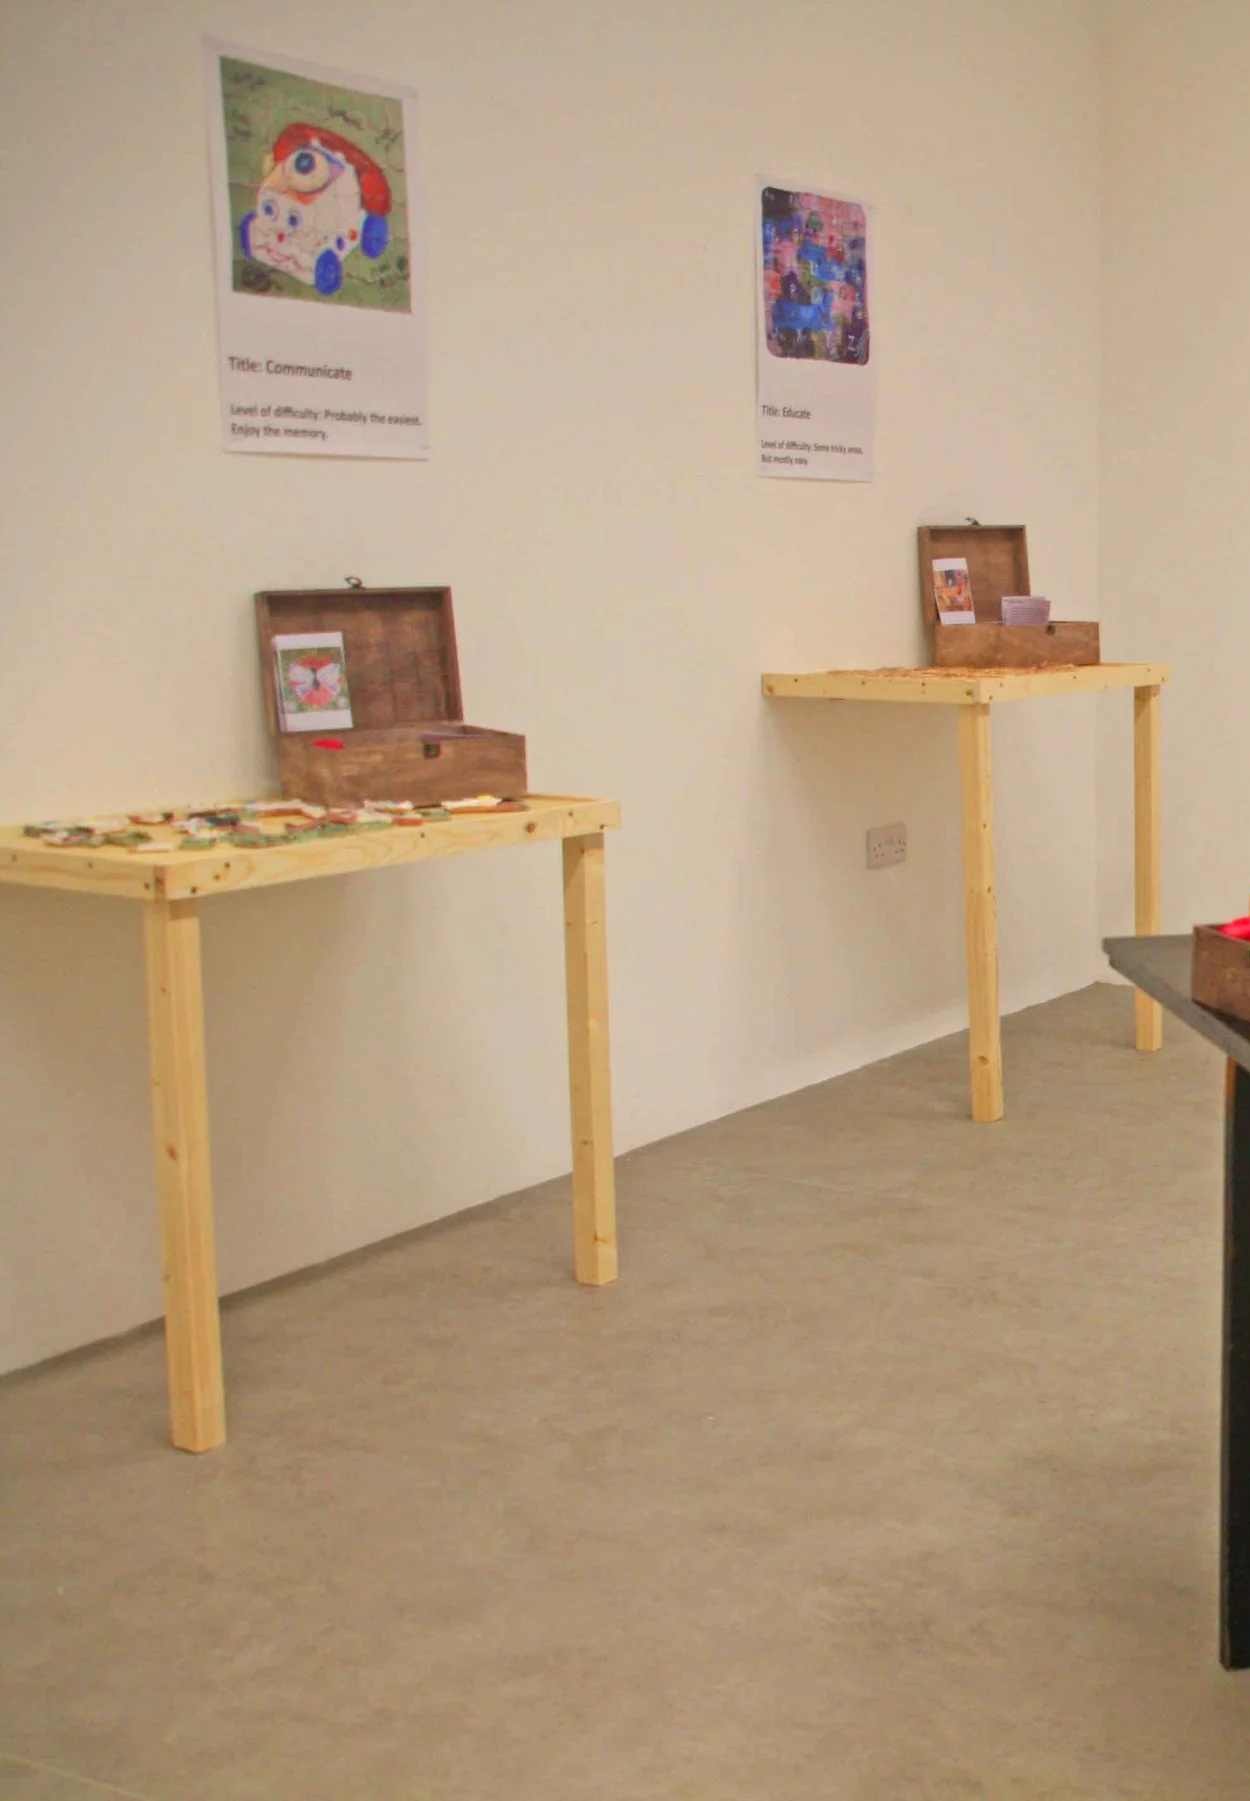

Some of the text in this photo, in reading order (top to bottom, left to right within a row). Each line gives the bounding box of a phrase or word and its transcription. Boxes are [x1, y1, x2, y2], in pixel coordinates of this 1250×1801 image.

[228, 356, 352, 380] Title: Communicate
[230, 404, 423, 426] Level of difficulty: Probably the easiest.
[761, 405, 811, 420] Title: Educate
[231, 423, 328, 441] Enjoy the memory.
